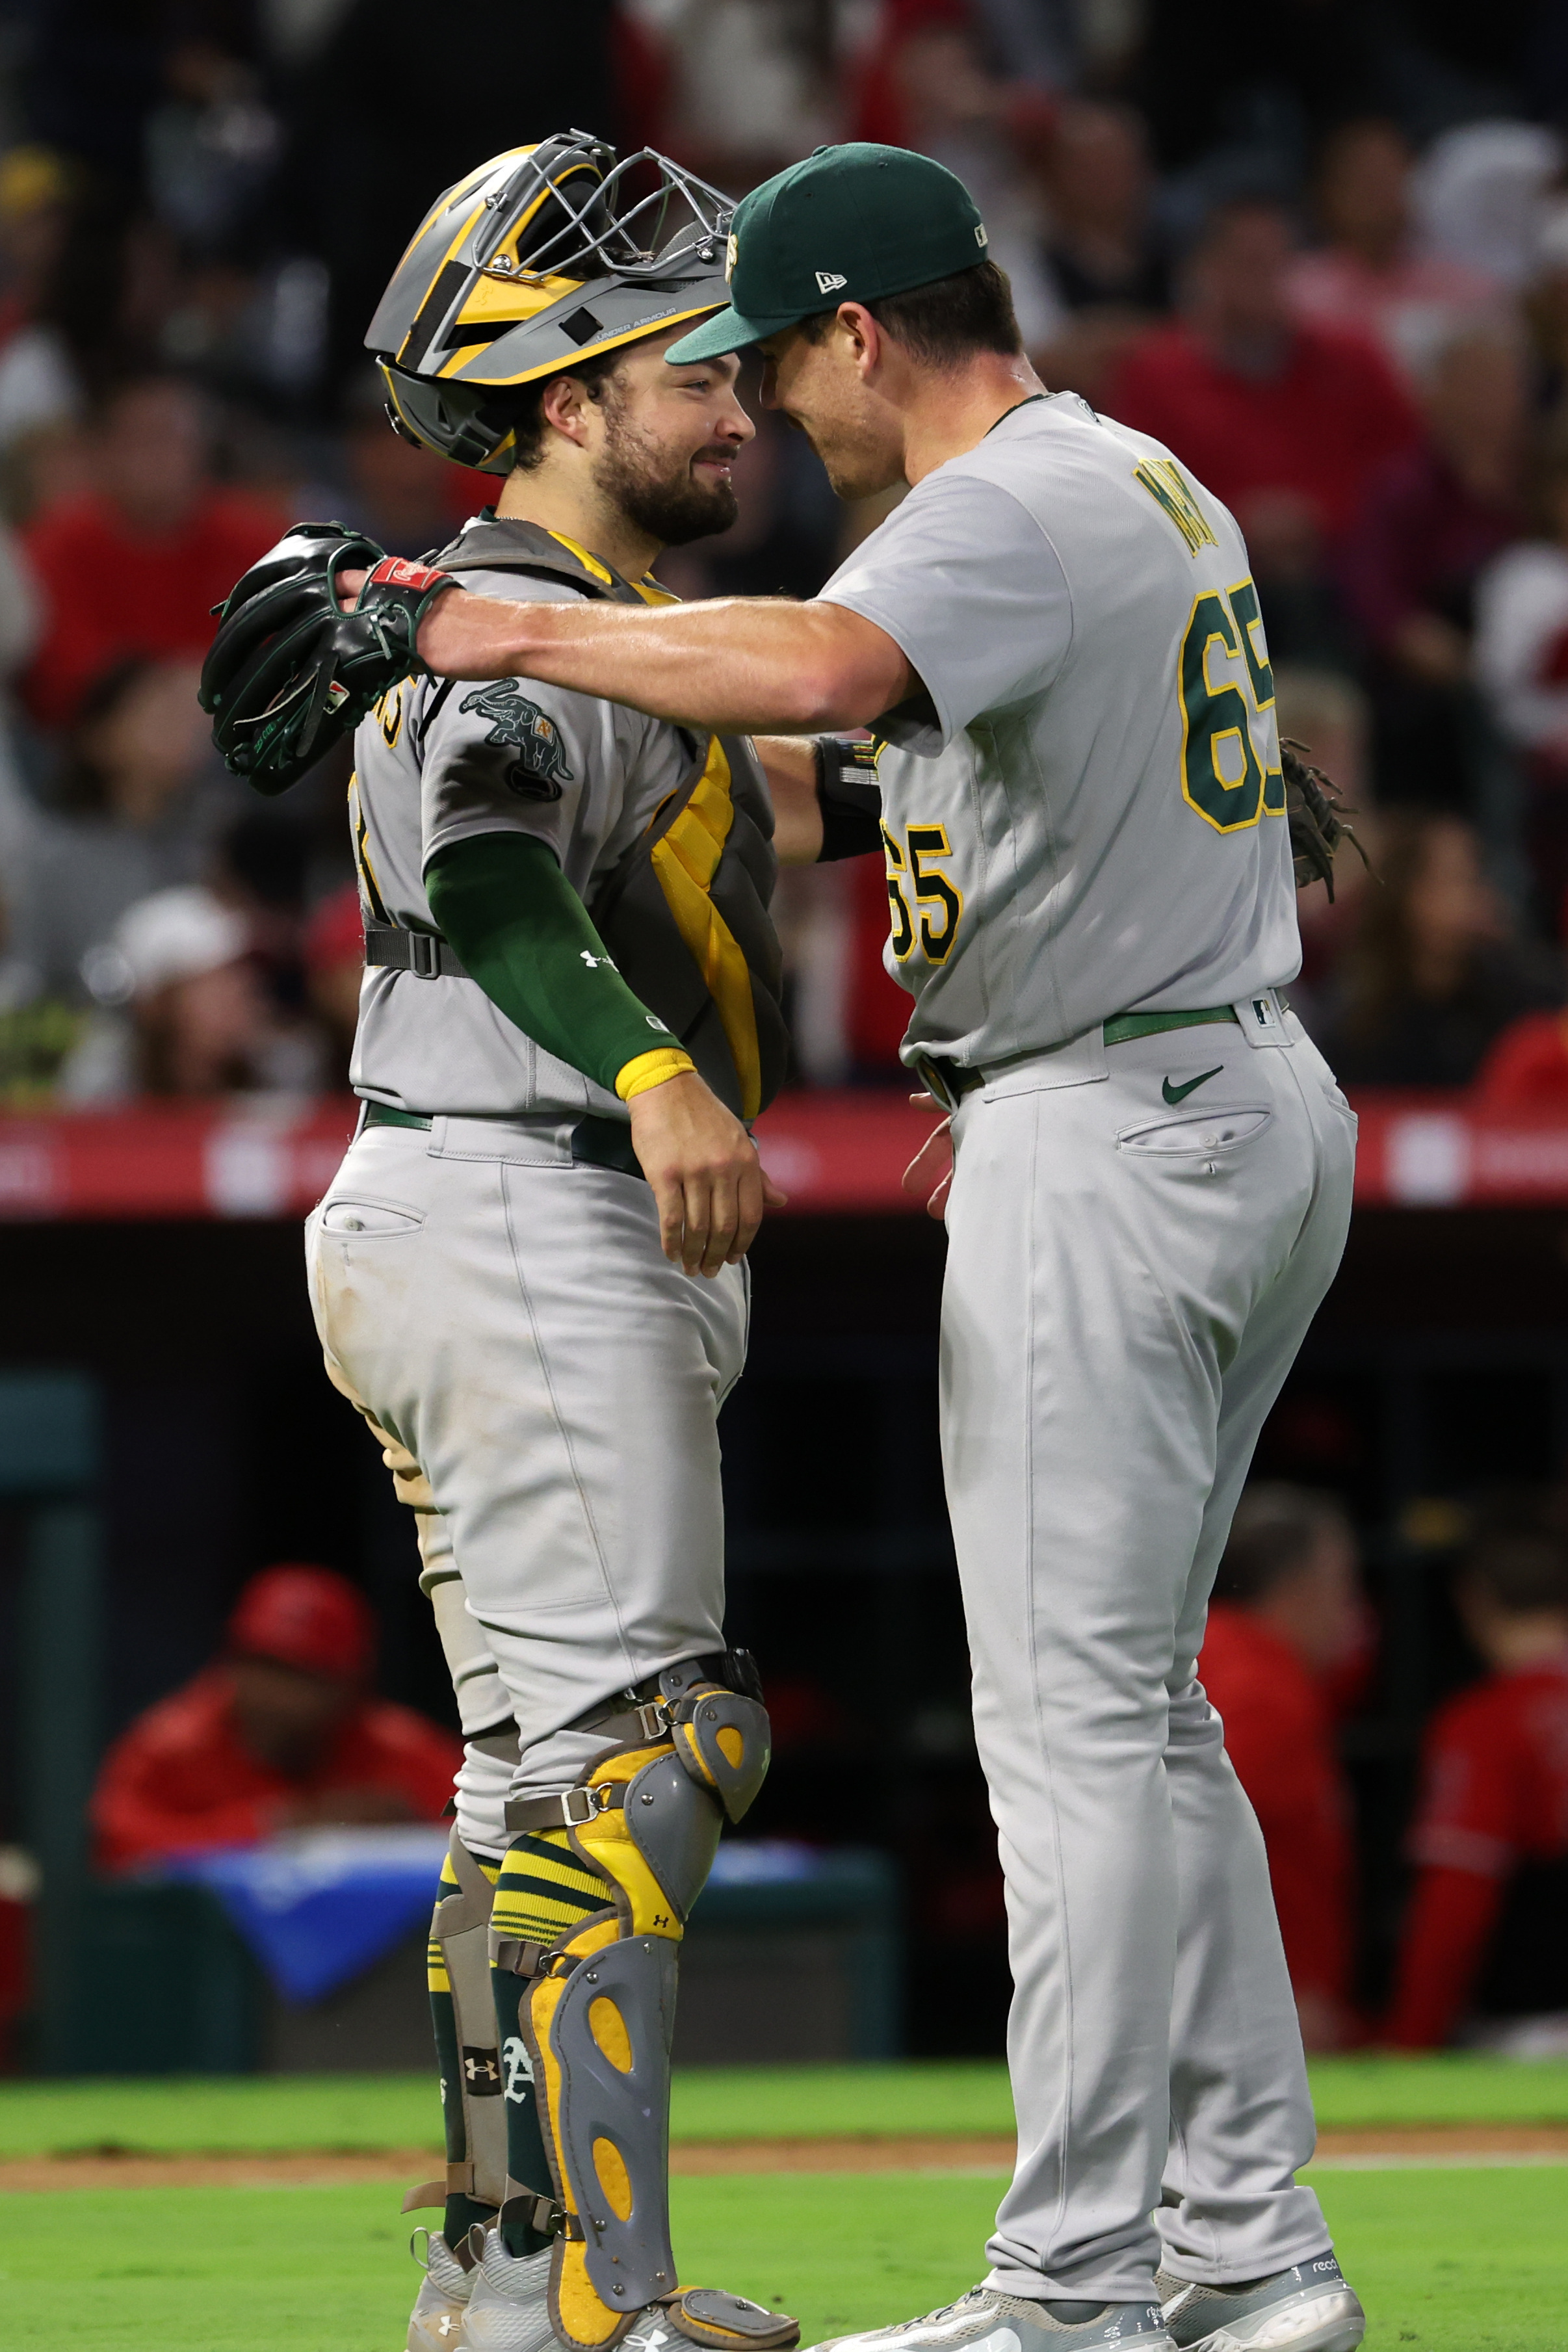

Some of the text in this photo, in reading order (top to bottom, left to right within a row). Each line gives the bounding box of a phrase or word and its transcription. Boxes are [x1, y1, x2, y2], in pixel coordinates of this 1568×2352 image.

[596, 307, 677, 341] UNDER ARMOUR
[1177, 575, 1287, 835] 65
[879, 817, 963, 965] 65
